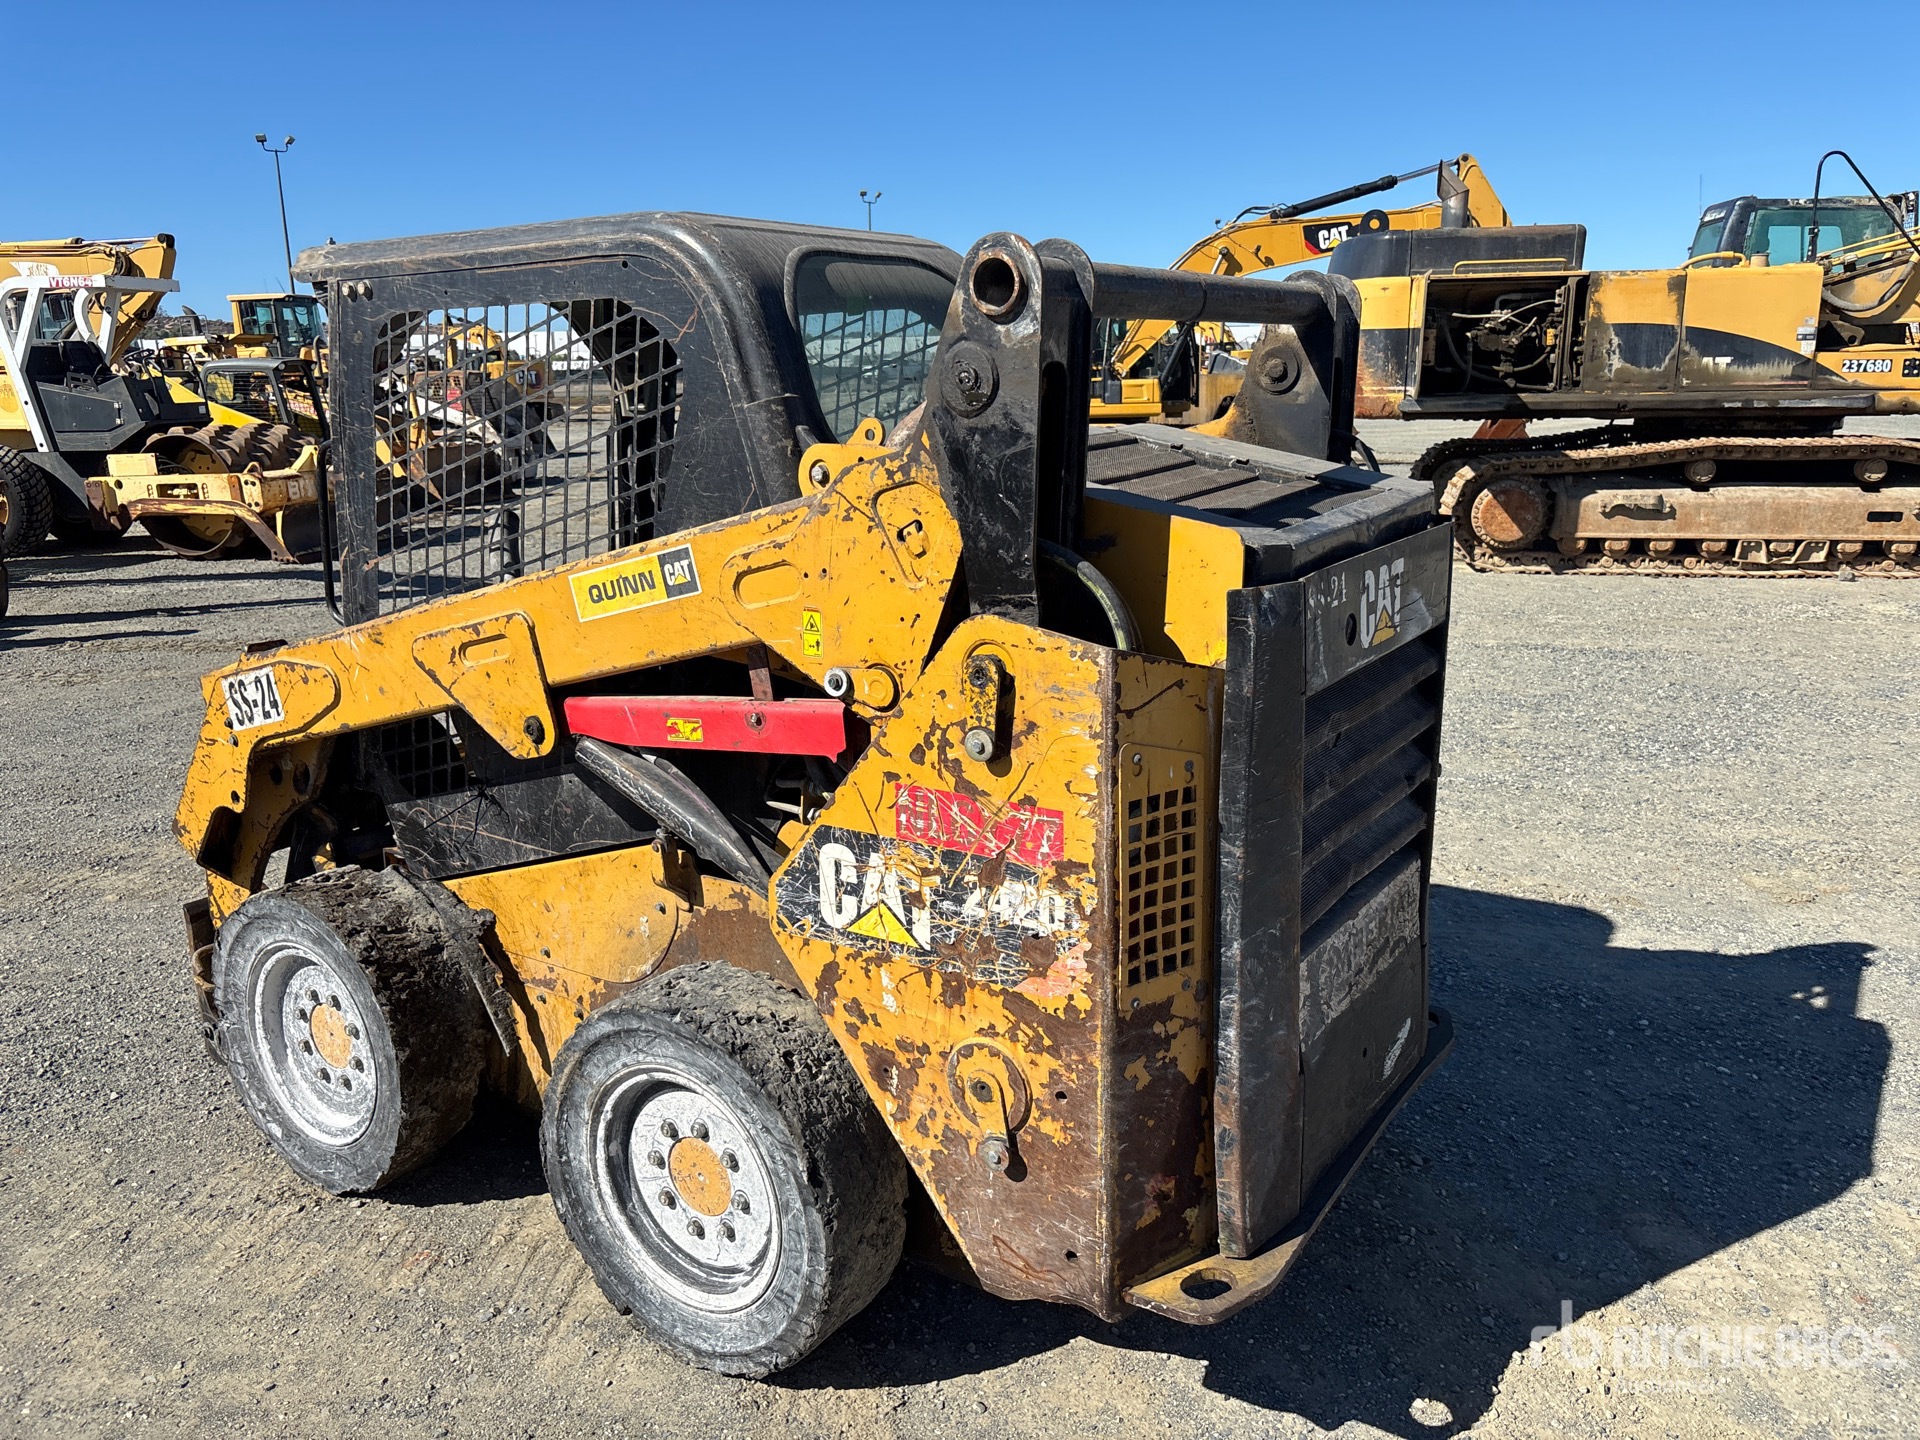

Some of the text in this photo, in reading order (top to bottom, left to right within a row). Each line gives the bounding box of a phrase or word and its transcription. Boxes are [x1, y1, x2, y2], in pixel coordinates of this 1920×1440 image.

[1318, 225, 1348, 250] CAT
[1842, 358, 1892, 373] 237680
[588, 559, 691, 604] QUINN CAT
[1360, 557, 1405, 649] CAT
[228, 673, 280, 726] SS-24
[819, 842, 941, 951] CAT
